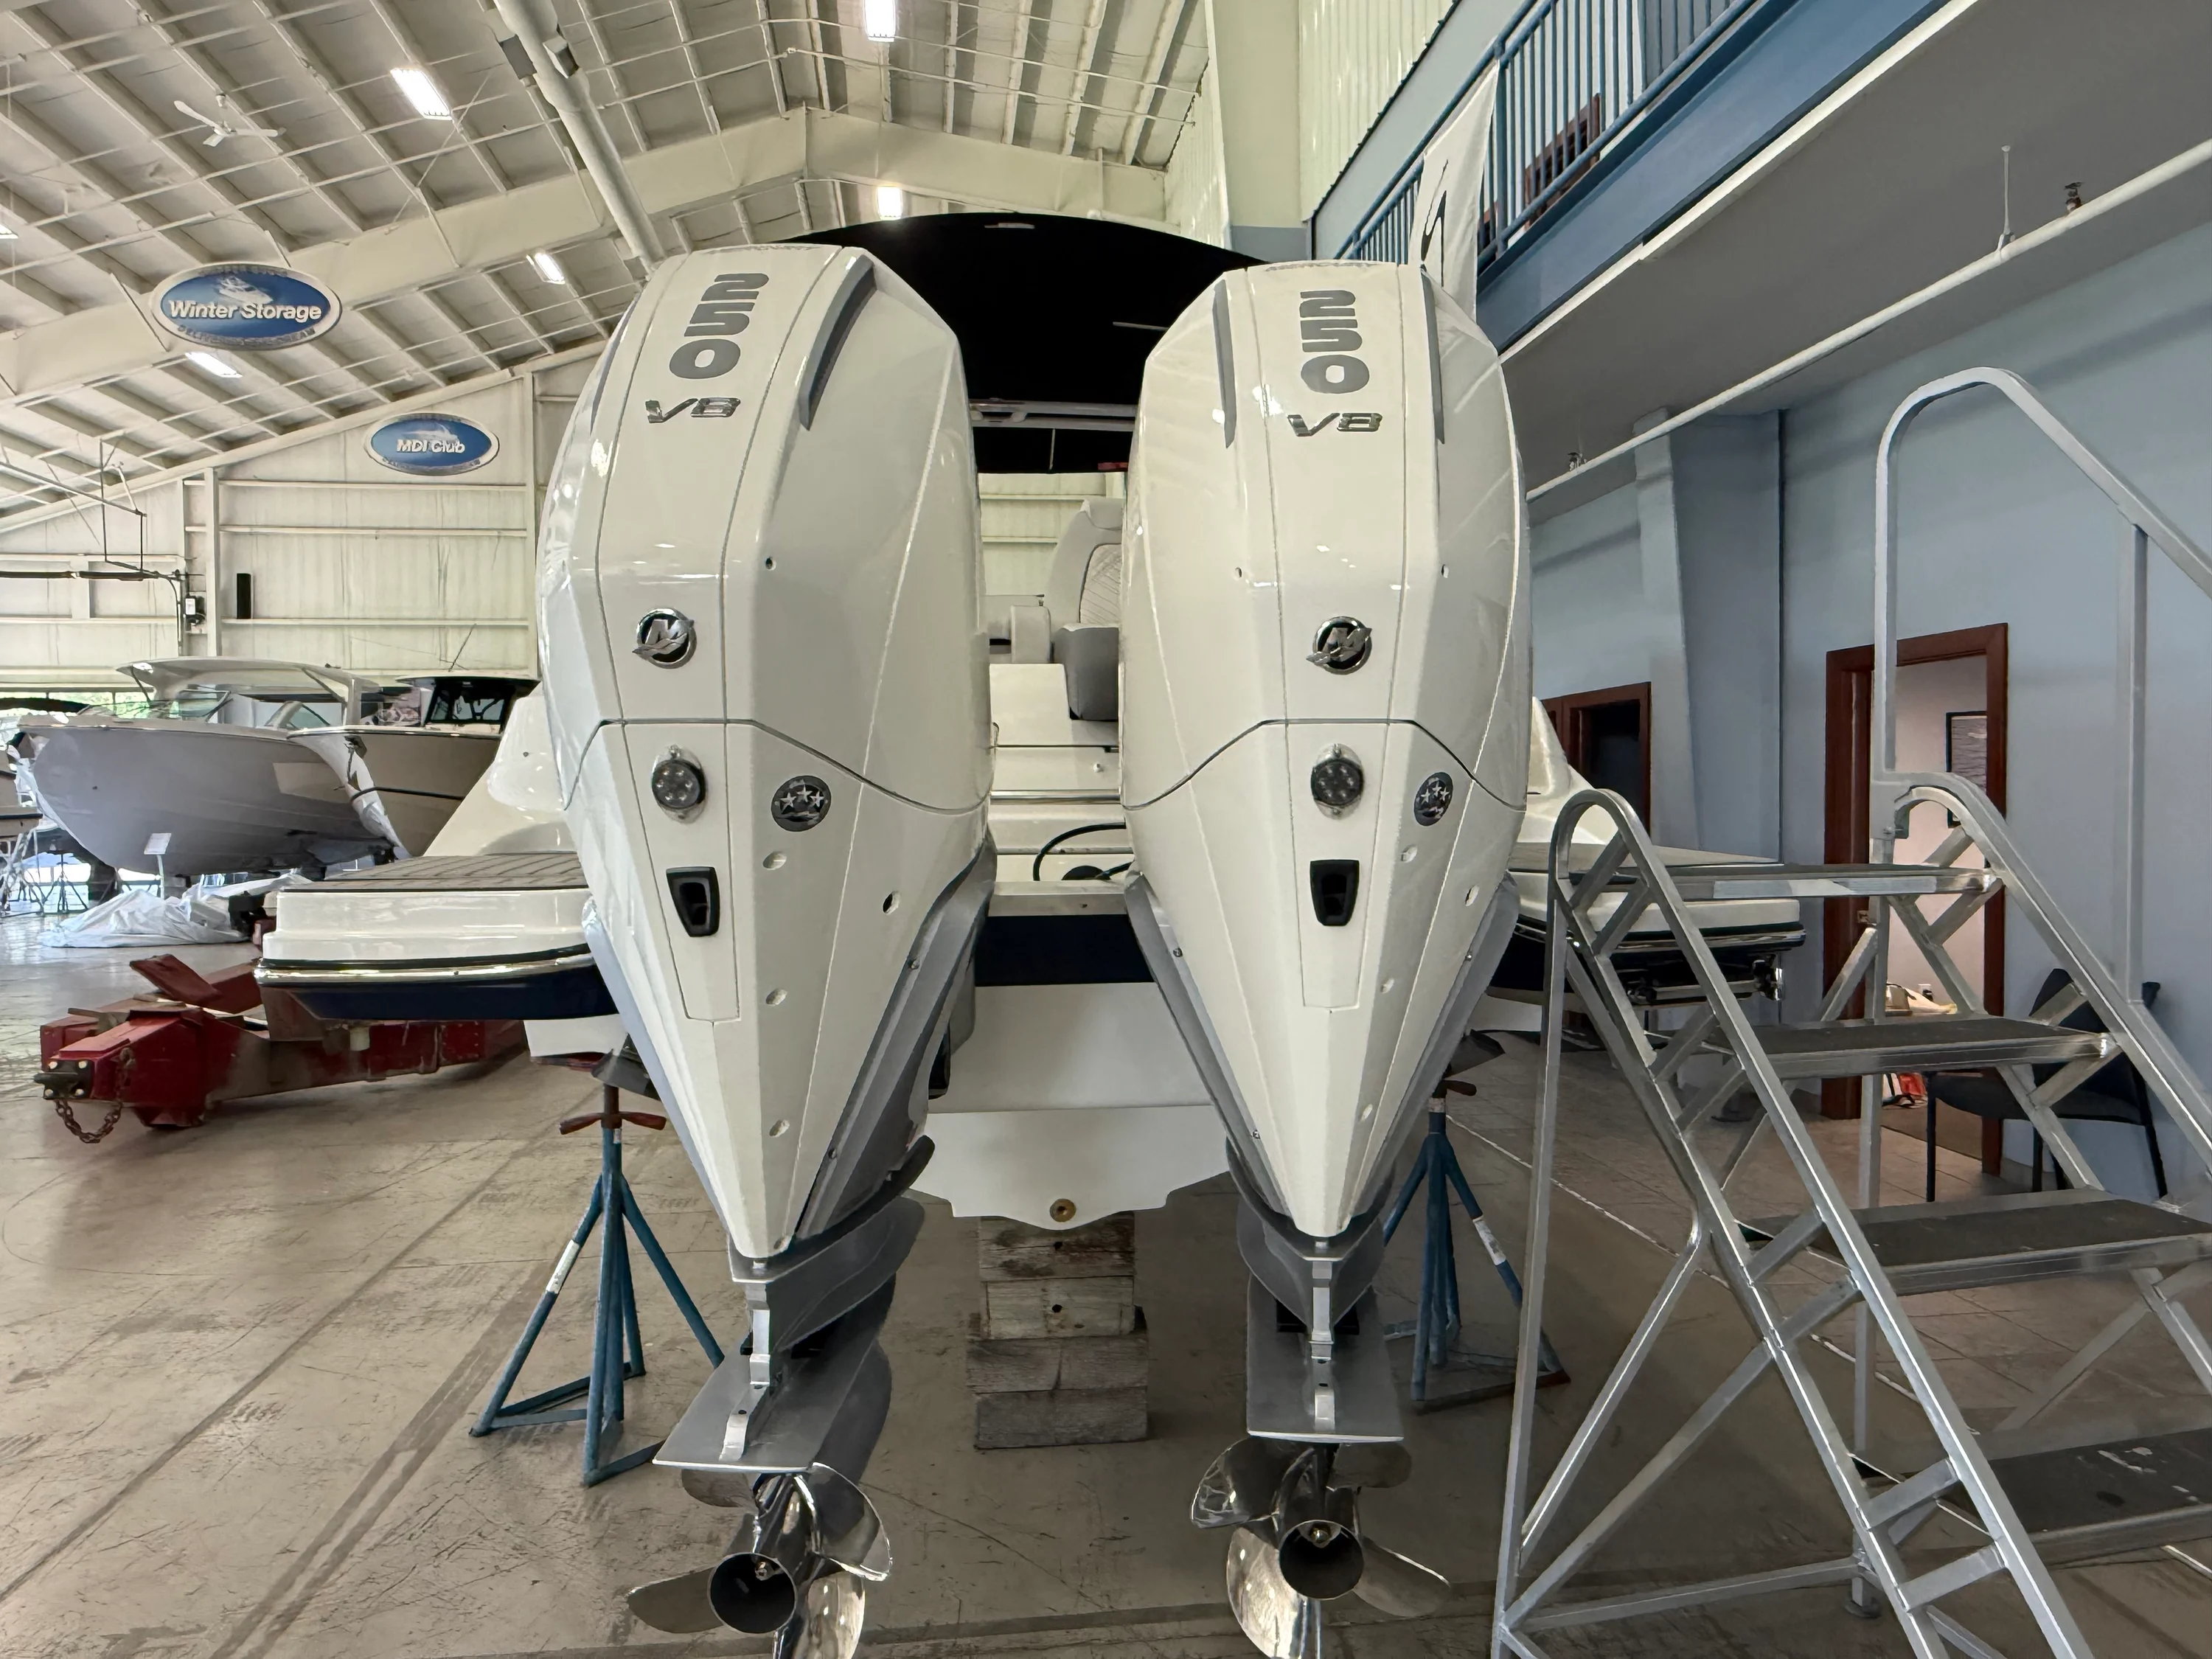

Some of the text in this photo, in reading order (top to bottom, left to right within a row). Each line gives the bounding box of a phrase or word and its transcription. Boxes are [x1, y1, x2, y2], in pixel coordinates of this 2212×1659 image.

[170, 299, 321, 323] Winter Storage
[669, 273, 769, 379] 250
[1299, 290, 1369, 394] 250
[645, 397, 741, 423] V8
[1287, 413, 1382, 437] V8
[396, 439, 465, 453] MDI Club
